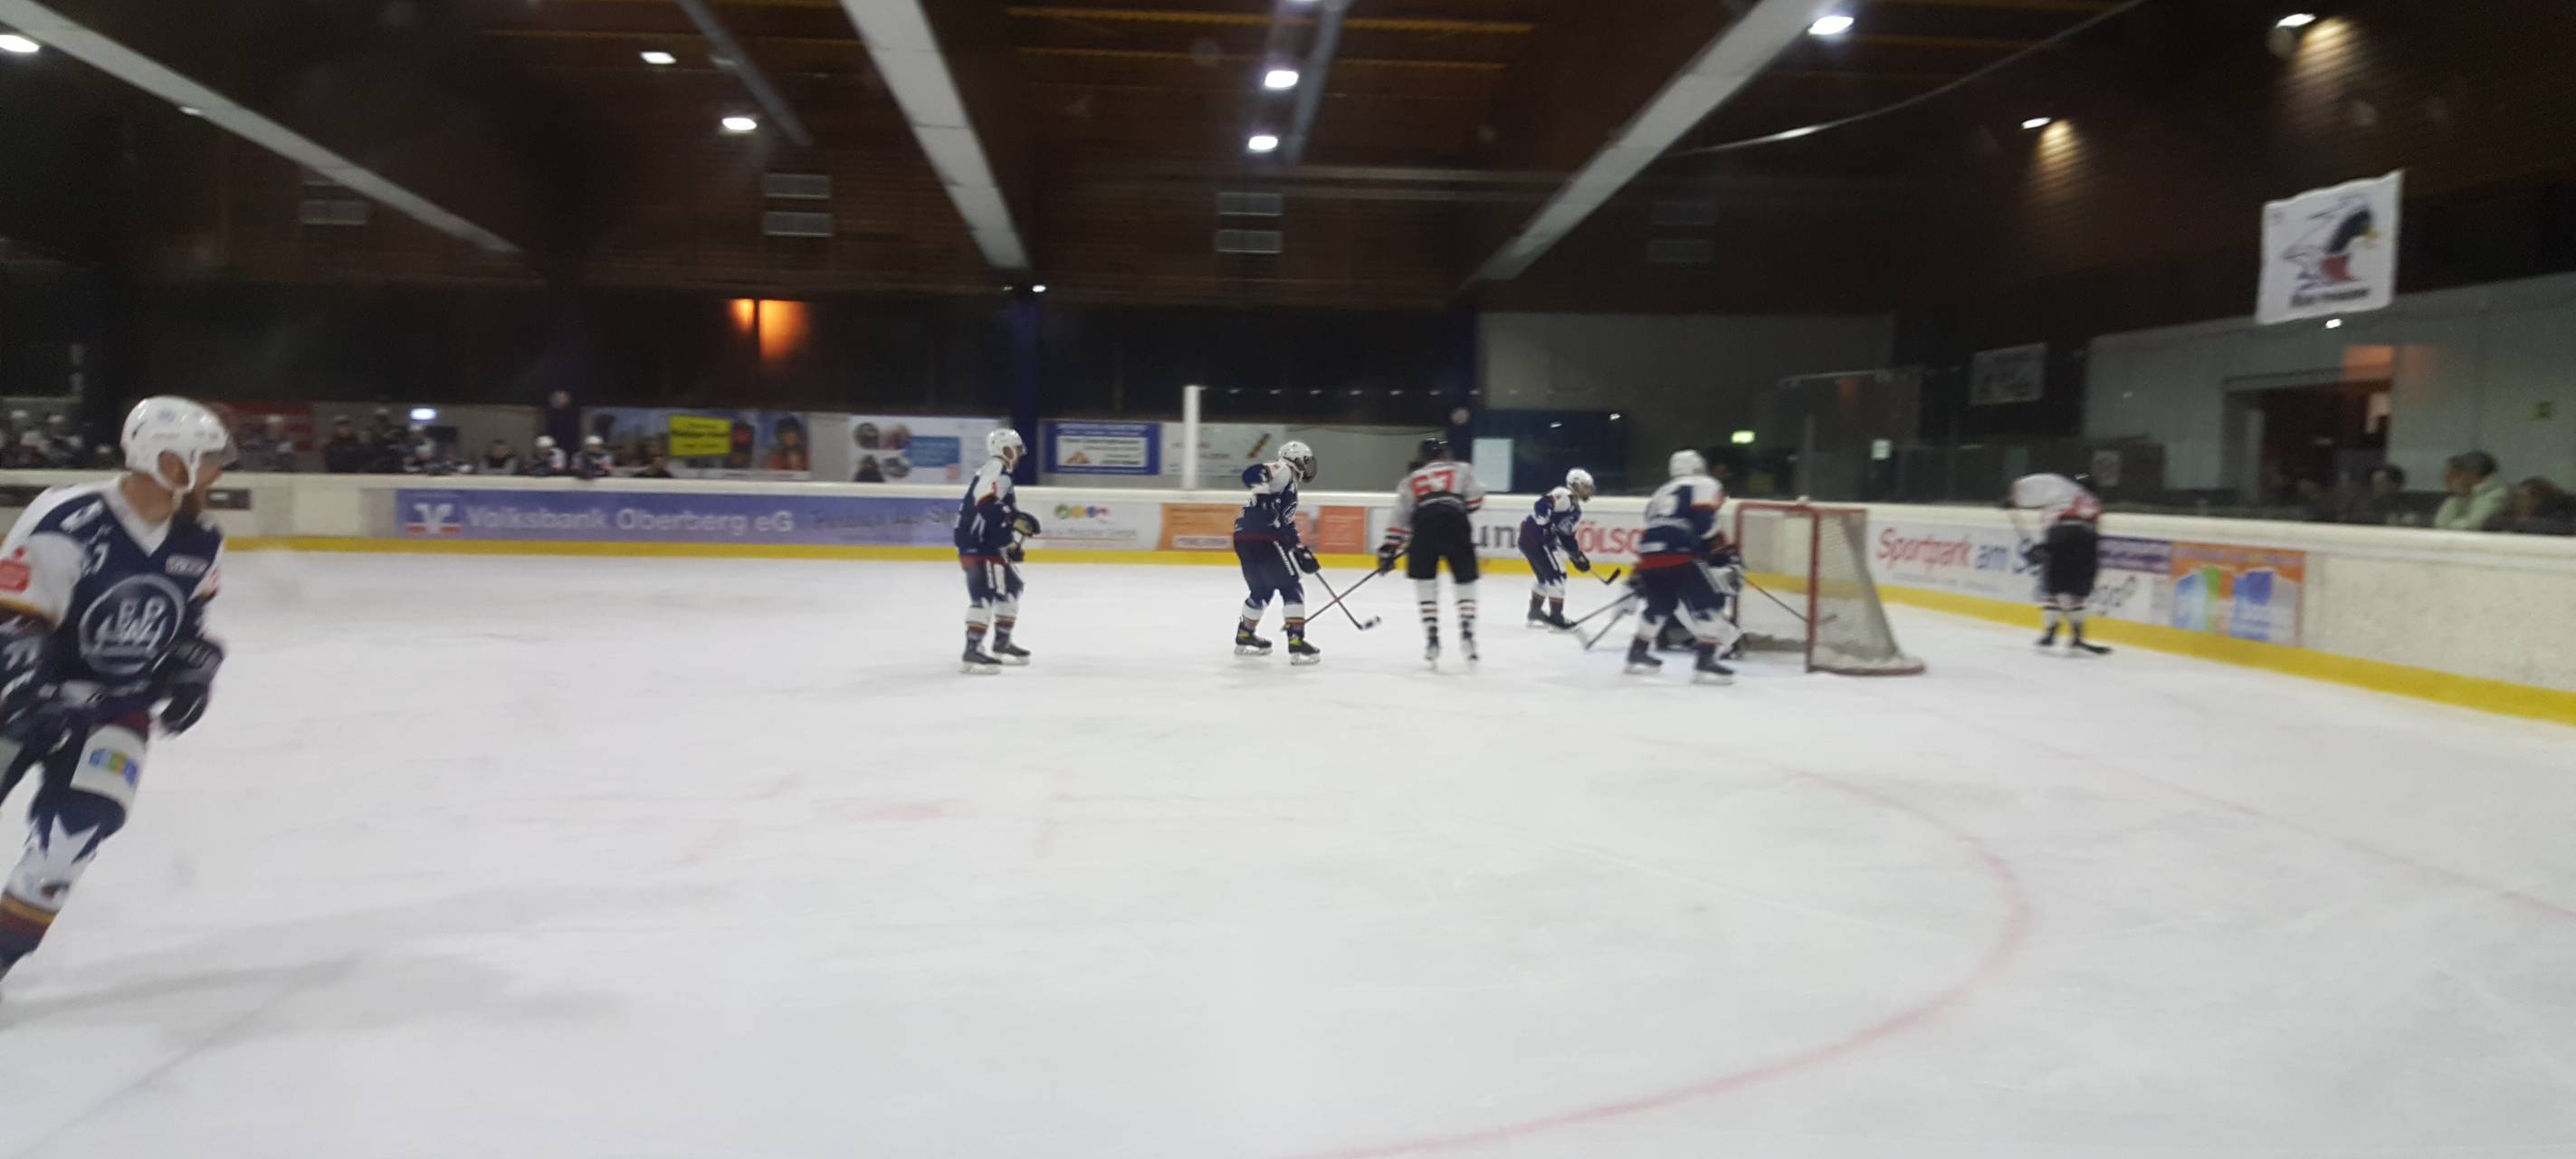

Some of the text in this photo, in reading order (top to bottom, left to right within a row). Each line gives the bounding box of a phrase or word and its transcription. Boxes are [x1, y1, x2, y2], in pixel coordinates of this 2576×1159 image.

[1410, 470, 1455, 496] 67
[466, 506, 607, 529] Volksbank
[616, 508, 749, 536] Oberberg
[754, 511, 795, 532] eG
[1876, 527, 1971, 571] Sportpark
[1975, 544, 2009, 570] am
